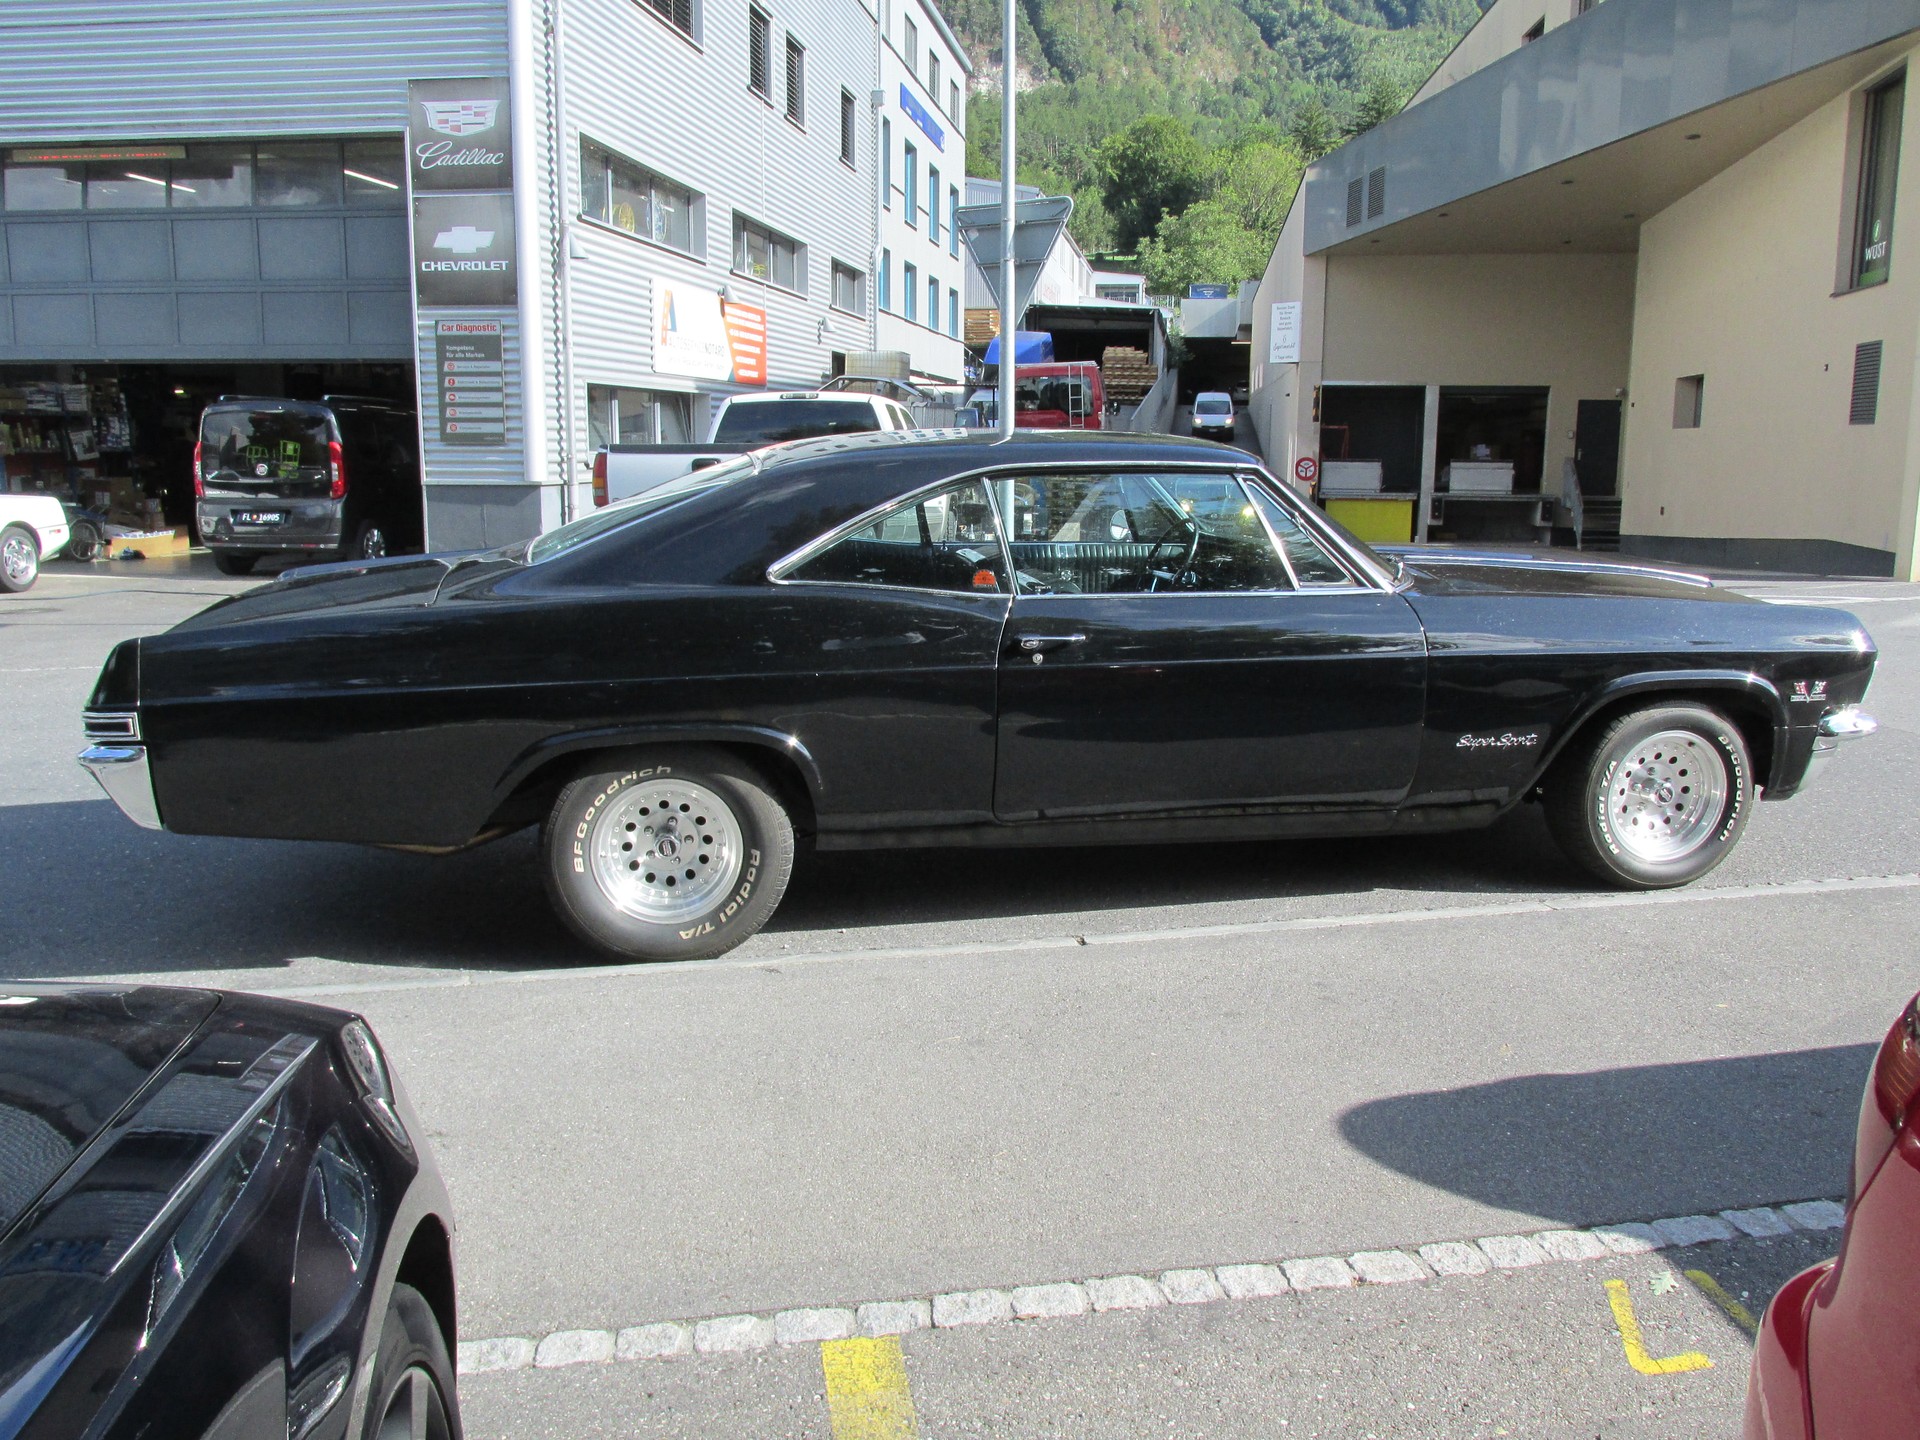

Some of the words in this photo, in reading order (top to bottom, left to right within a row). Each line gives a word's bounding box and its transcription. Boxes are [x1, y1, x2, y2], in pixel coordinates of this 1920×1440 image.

[415, 140, 505, 170] Cadillac
[421, 260, 509, 272] CHEVROLET
[441, 323, 454, 332] Car
[455, 323, 497, 334] Diagnostic
[242, 513, 251, 521] FL
[1456, 734, 1496, 751] Super
[1497, 732, 1538, 750] Sport
[1601, 760, 1618, 788] T/A
[1717, 735, 1743, 842] BFGoodrich
[573, 765, 671, 873] BFGoodrich
[1598, 796, 1620, 855] Radial
[719, 849, 760, 923] Radial
[679, 922, 715, 940] T/A
